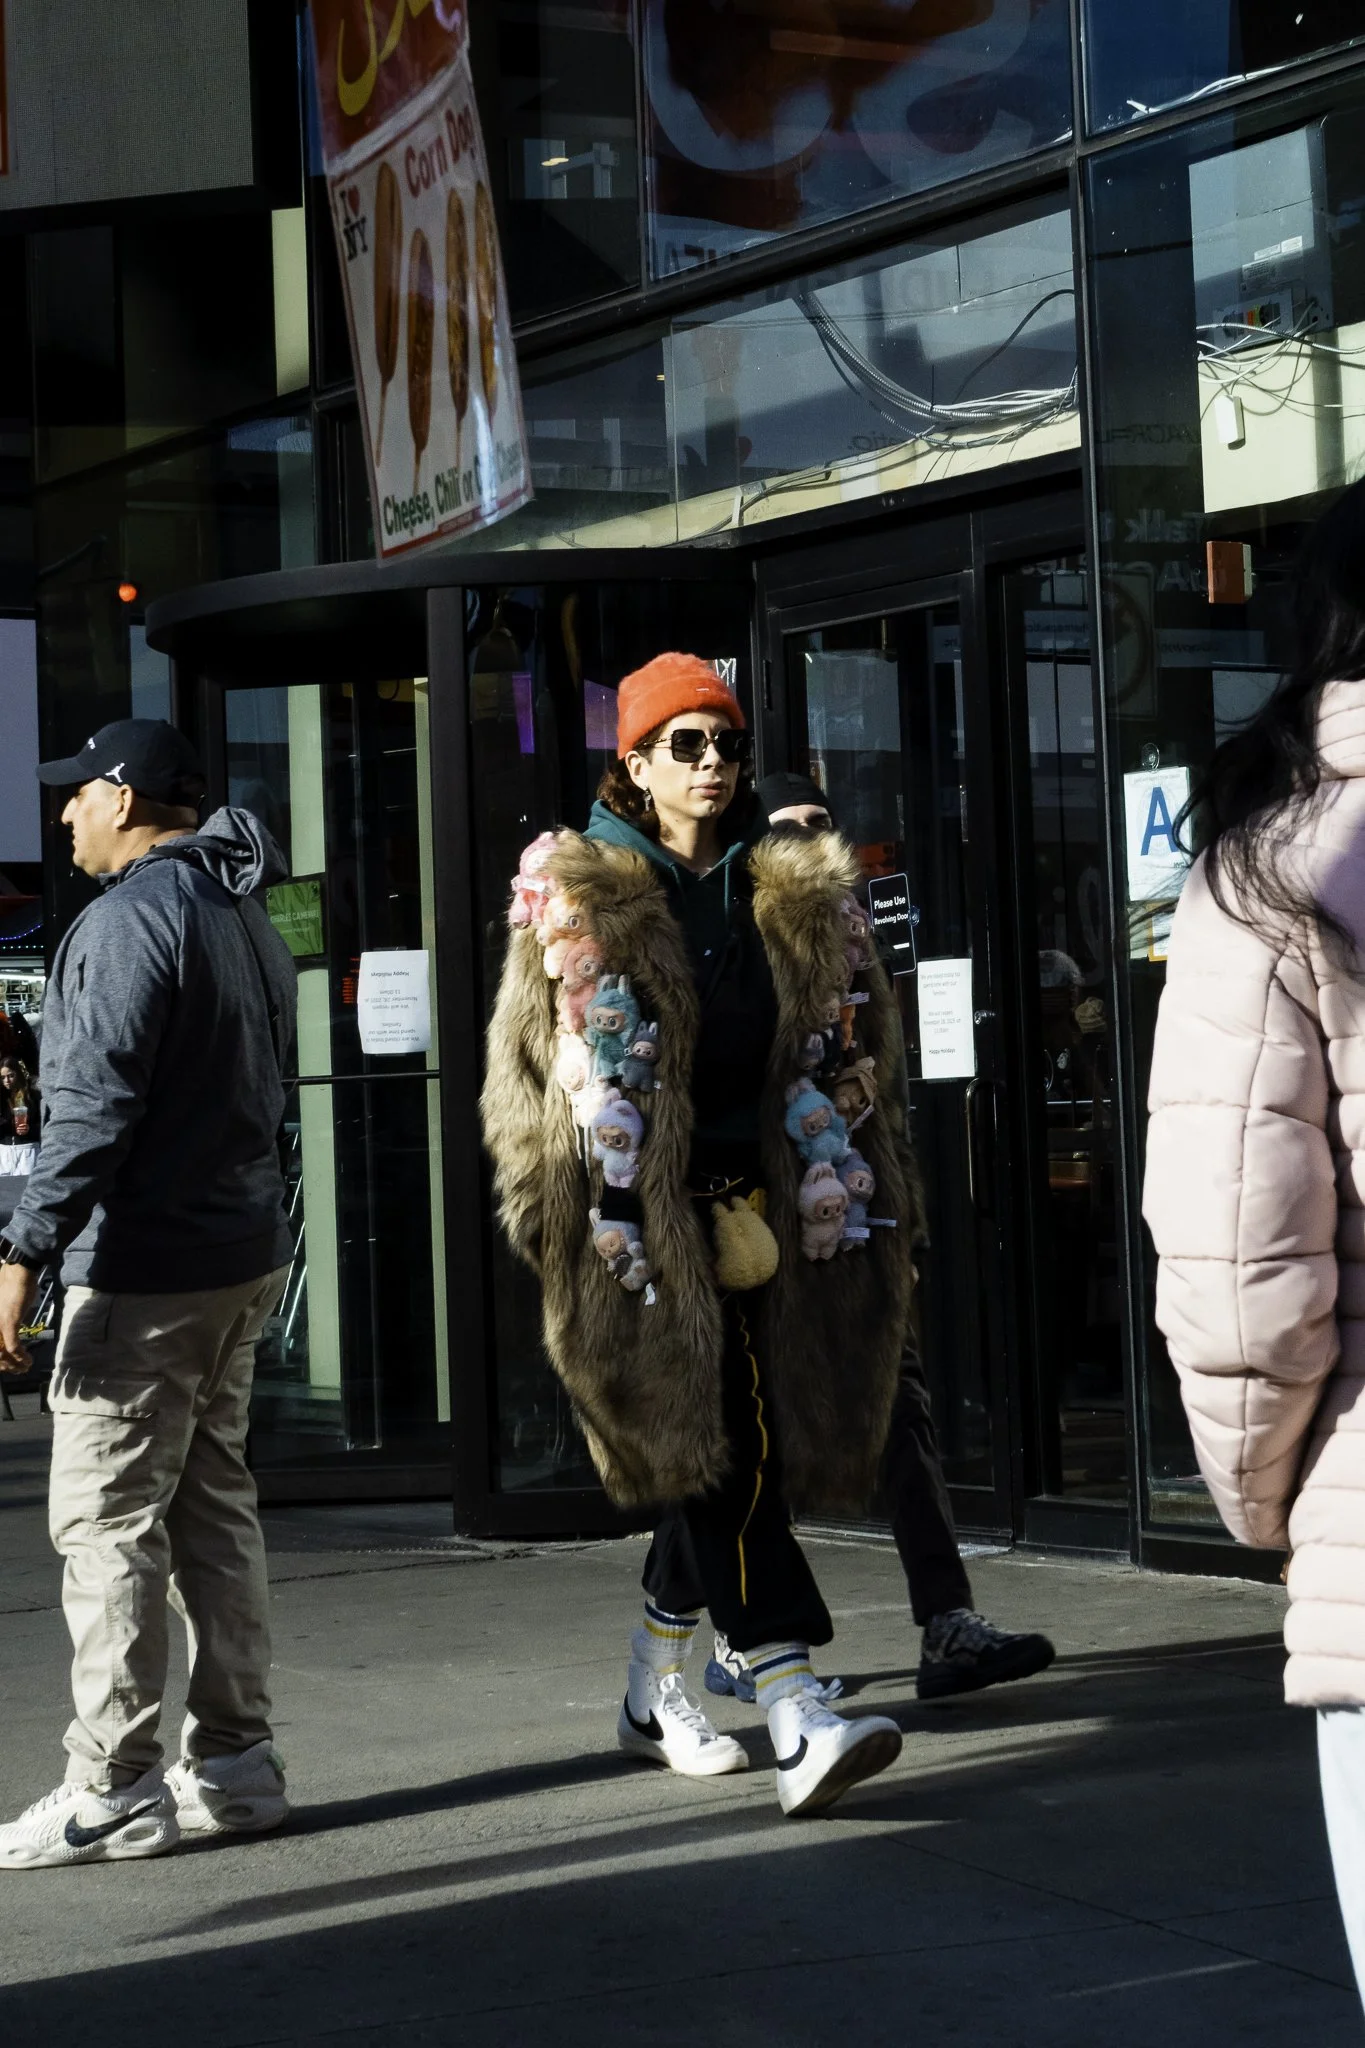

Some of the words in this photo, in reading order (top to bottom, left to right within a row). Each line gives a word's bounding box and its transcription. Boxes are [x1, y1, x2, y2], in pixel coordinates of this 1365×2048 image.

[404, 132, 448, 199] Corn
[343, 216, 368, 262] NY
[383, 491, 435, 536] Cheese,
[434, 466, 462, 515] Chili
[462, 470, 474, 502] or
[1140, 786, 1179, 856] A
[873, 899, 893, 910] Please
[893, 895, 906, 906] Use
[873, 914, 897, 926] Revolving
